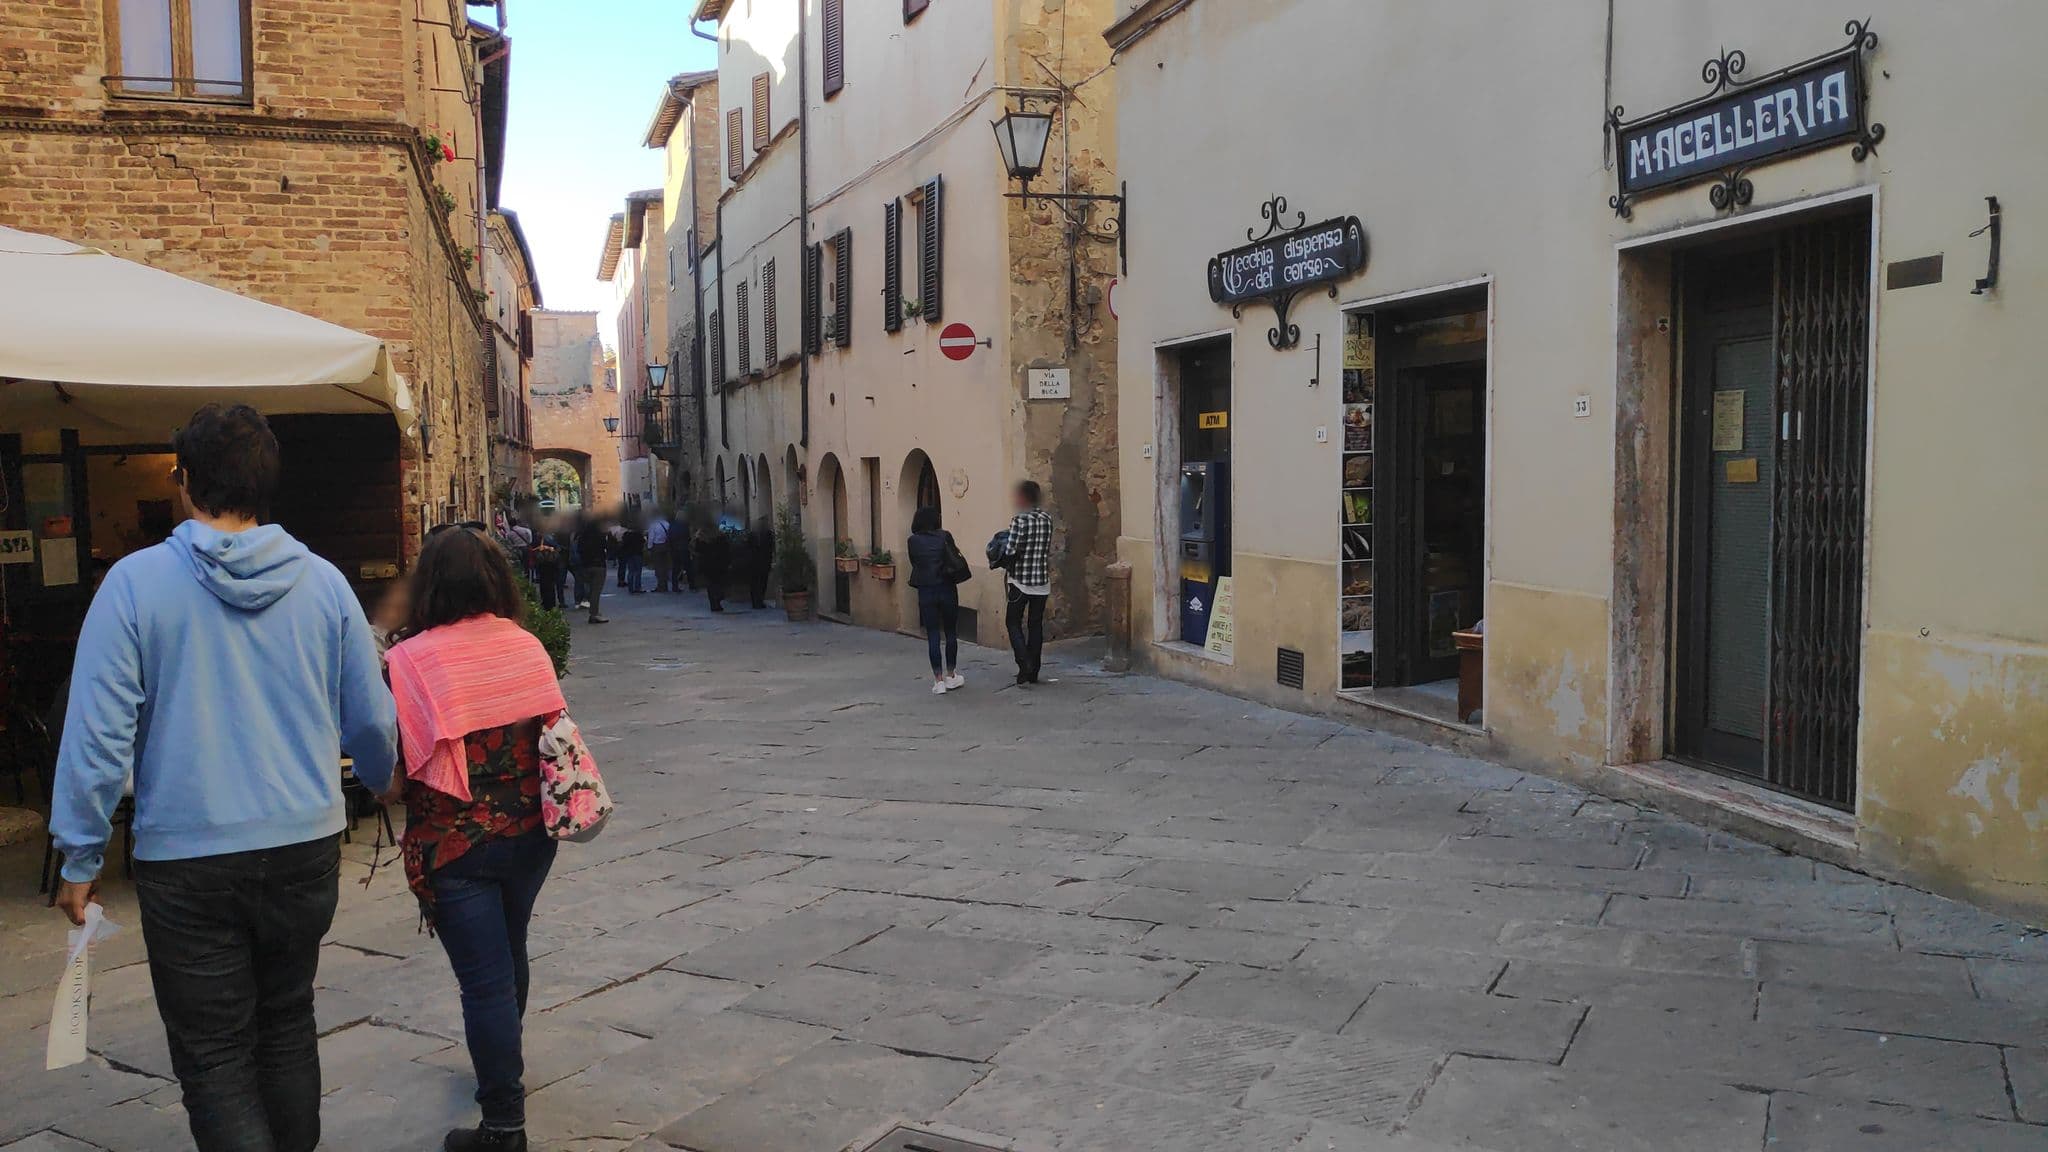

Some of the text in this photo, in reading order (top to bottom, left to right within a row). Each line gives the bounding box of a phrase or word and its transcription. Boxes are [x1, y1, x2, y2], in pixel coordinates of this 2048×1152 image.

[1629, 70, 1849, 179] MACELLERIA
[1221, 227, 1344, 295] Vecchia dispensa
[1255, 257, 1323, 290] del corso
[1205, 415, 1220, 427] ATM
[71, 956, 84, 1036] BOOKSHOP
